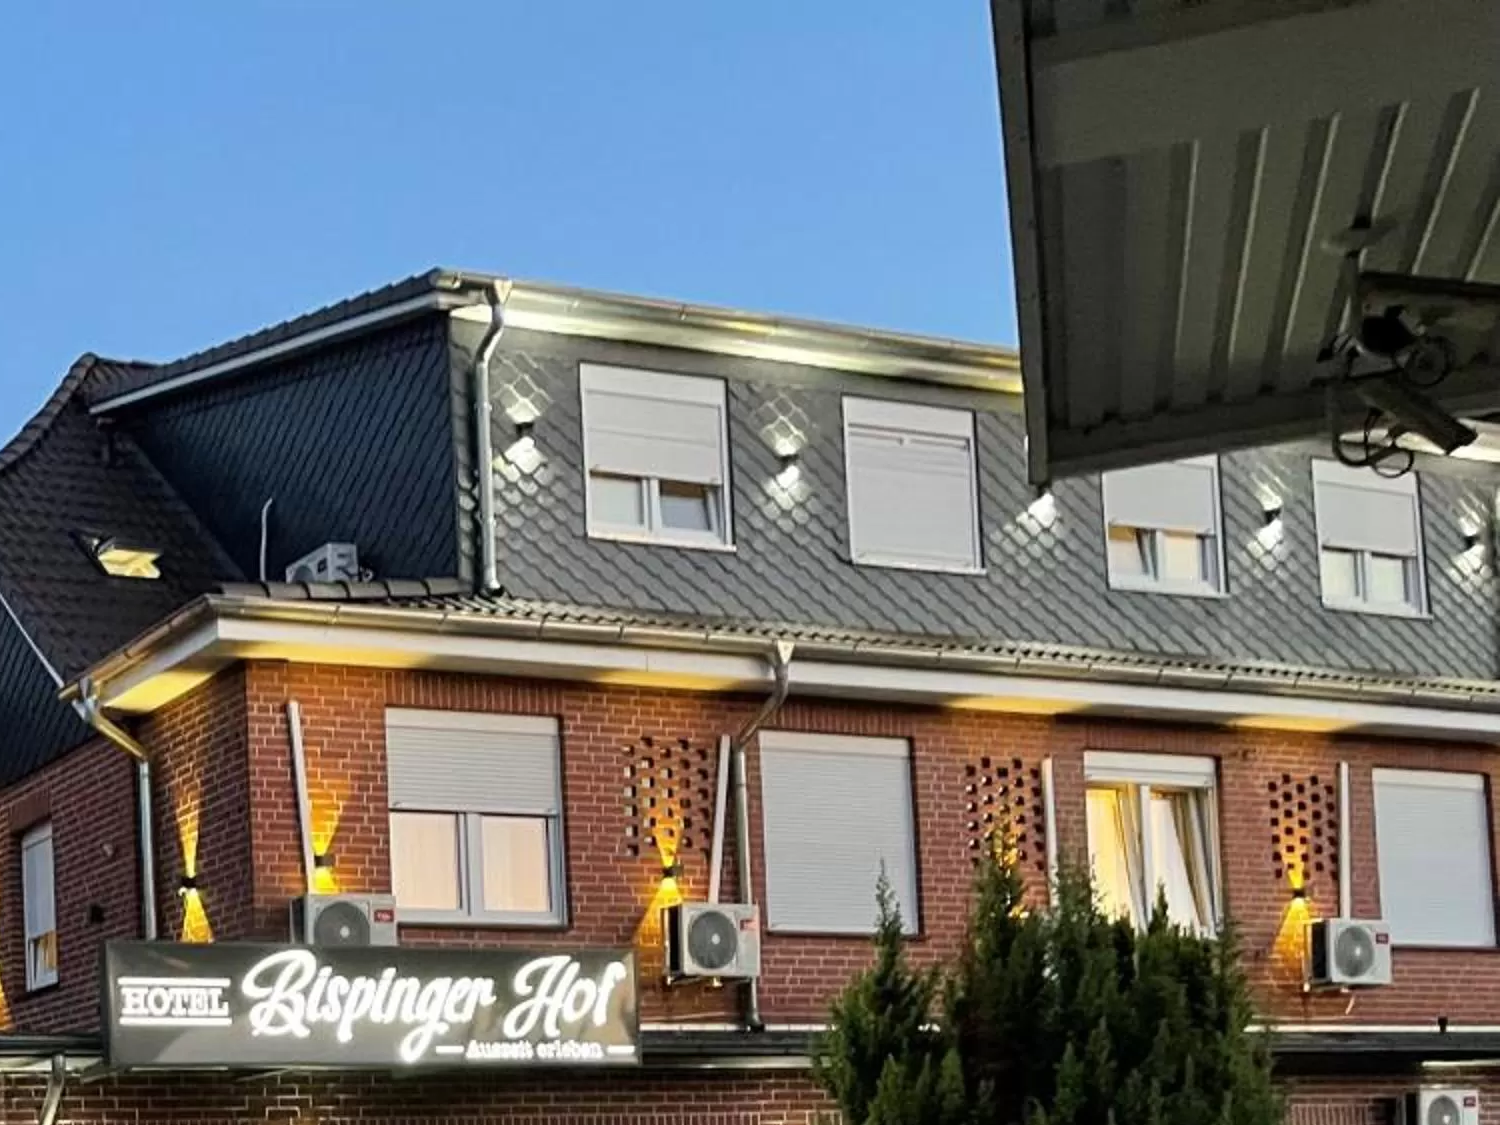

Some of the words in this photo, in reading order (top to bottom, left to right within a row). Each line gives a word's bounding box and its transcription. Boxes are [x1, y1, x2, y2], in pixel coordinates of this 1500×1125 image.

[121, 986, 229, 1017] HOTEL
[241, 949, 497, 1064] Bispinger
[503, 954, 627, 1039] Hof
